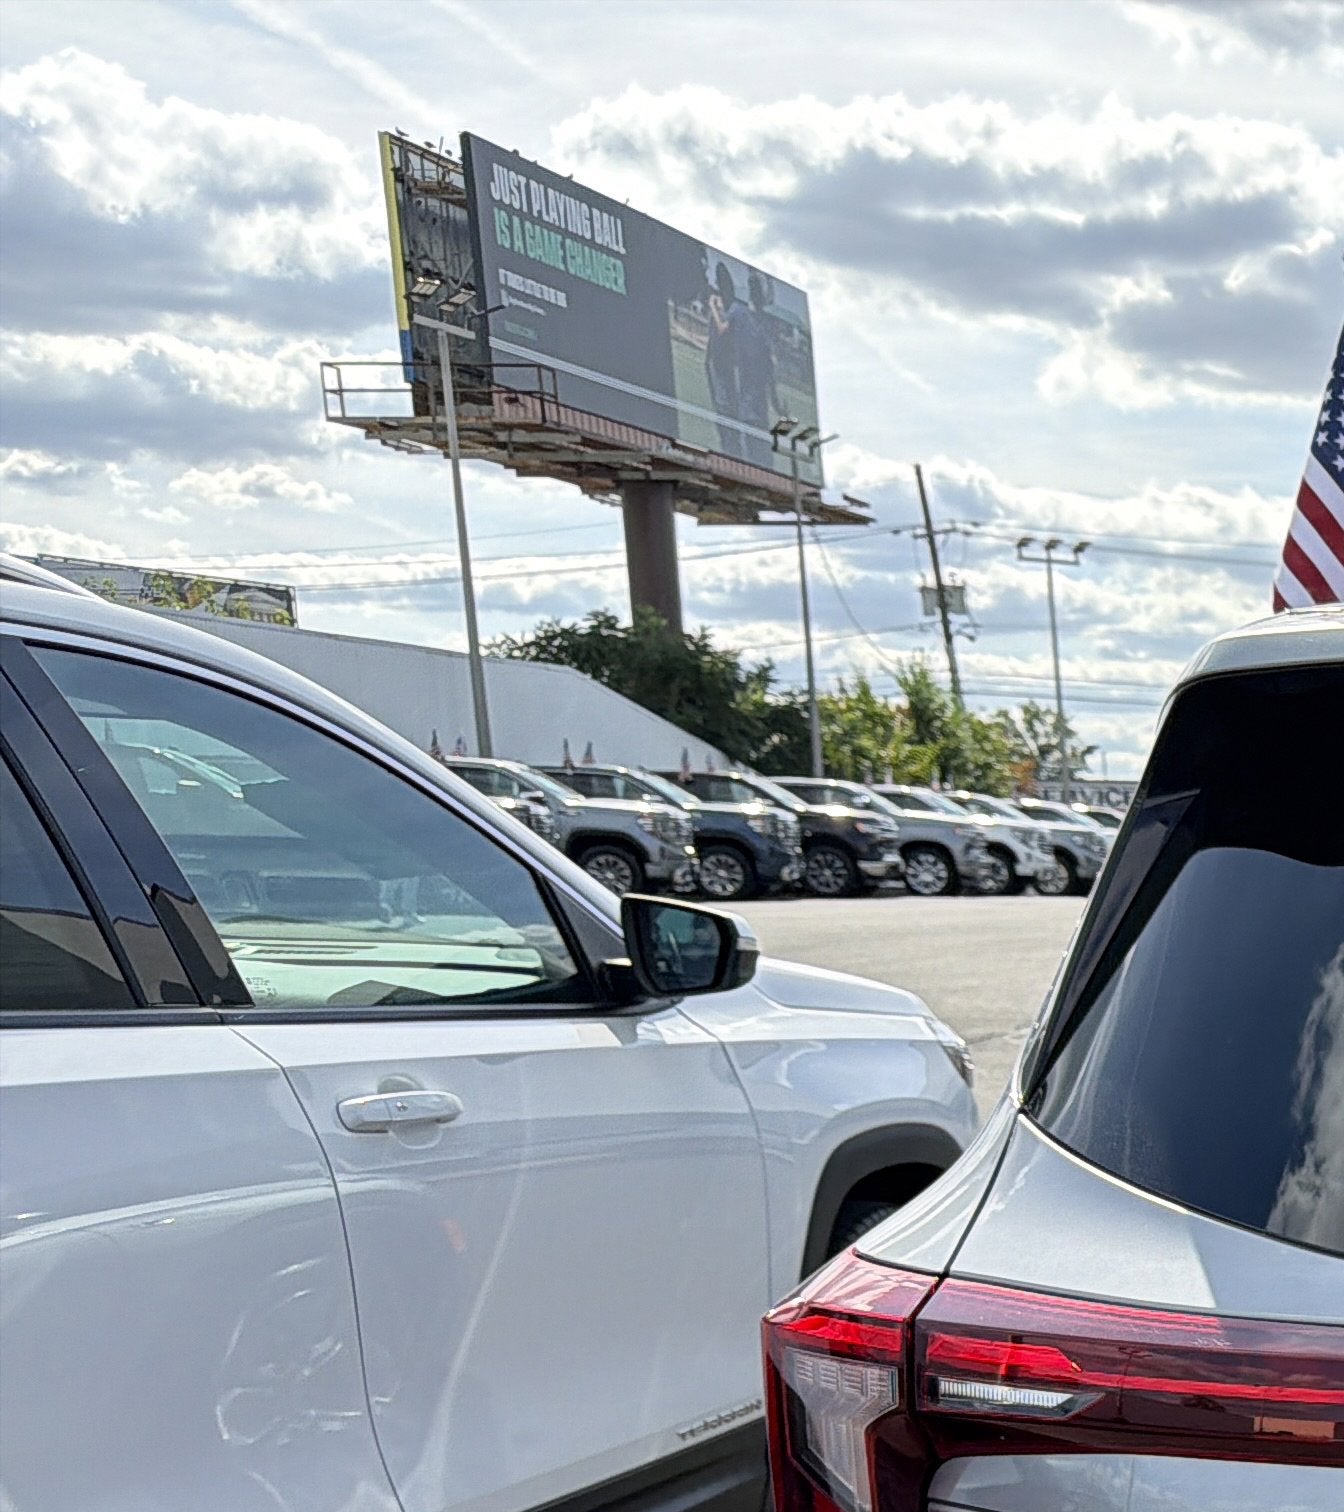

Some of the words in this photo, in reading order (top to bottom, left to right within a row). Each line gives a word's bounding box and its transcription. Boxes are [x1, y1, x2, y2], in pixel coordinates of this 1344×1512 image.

[490, 162, 528, 213] JUST
[529, 179, 592, 240] PLAYING
[591, 207, 627, 255] BALL
[493, 207, 511, 249] IS
[512, 214, 525, 255] A
[524, 220, 566, 272] GAME
